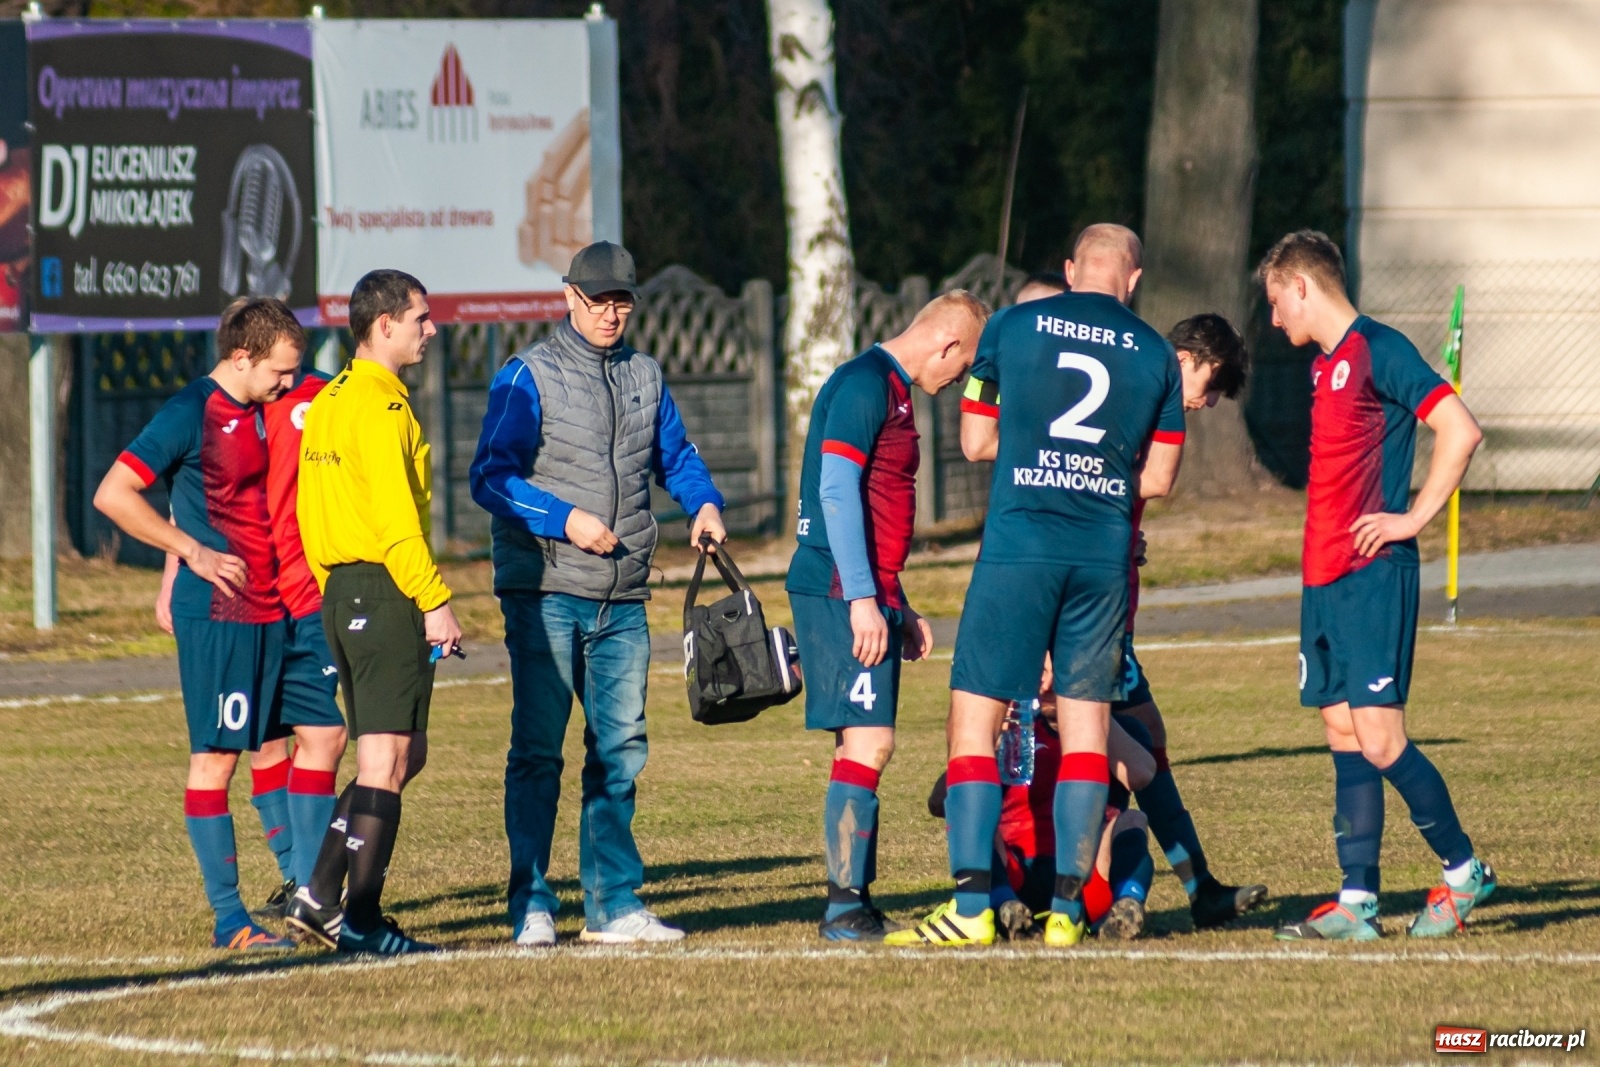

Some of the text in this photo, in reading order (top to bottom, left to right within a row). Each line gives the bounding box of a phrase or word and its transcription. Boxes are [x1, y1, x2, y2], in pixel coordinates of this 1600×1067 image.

[38, 63, 300, 121] Oprawa muzyczna imprez
[359, 88, 420, 130] ABIES
[91, 145, 198, 182] EUGENIUSZ
[38, 144, 89, 239] DJ
[89, 188, 195, 230] MIKOŁAJEK
[102, 260, 138, 295] 660
[139, 260, 171, 299] 623
[1036, 315, 1140, 351] HERBER S.
[1049, 352, 1111, 444] 2
[1013, 467, 1127, 496] KRZANOWICE
[1038, 449, 1105, 475] KS 1905
[217, 691, 250, 731] 10
[850, 671, 877, 711] 4
